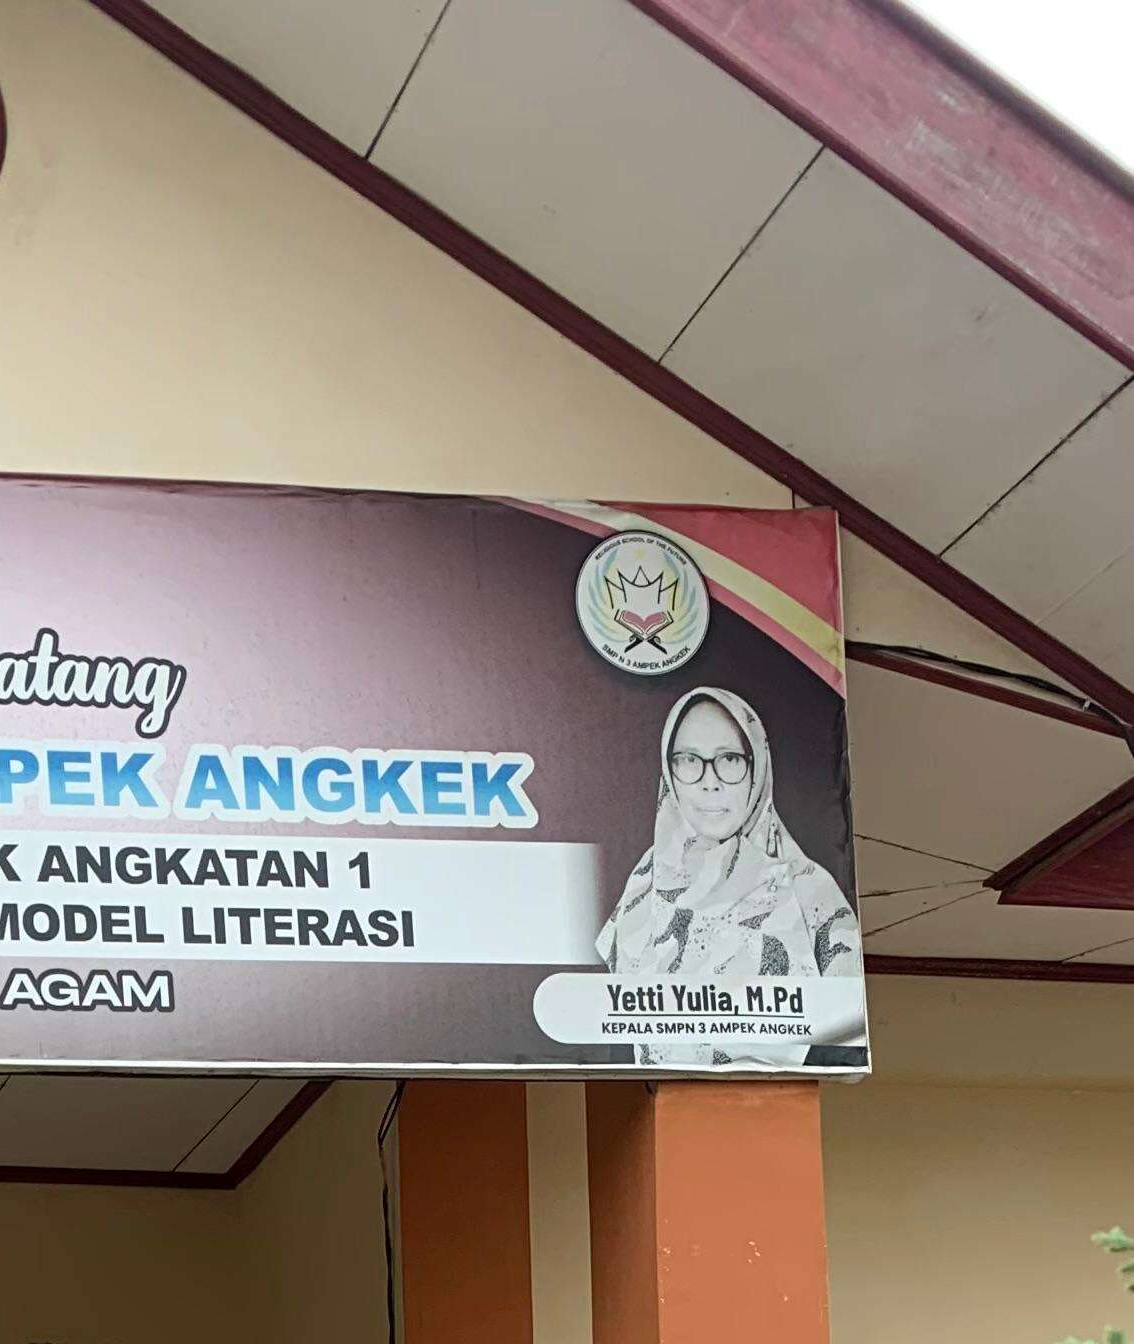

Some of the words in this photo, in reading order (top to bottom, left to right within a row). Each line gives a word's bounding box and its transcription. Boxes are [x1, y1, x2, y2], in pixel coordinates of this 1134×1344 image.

[632, 661, 661, 669] AMPEK
[662, 646, 691, 668] ANGKEK
[185, 753, 529, 818] ANGKEK
[37, 845, 330, 889] ANGKATAN
[348, 851, 372, 890] 1
[181, 907, 415, 947] LITERASI
[607, 983, 665, 1013] Yetti
[671, 984, 740, 1017] Yulia,
[747, 984, 805, 1014] M.Pd
[601, 1022, 652, 1035] KEPALA
[656, 1022, 695, 1035] SMPN
[698, 1022, 706, 1035] 3
[709, 1022, 756, 1036] AMPEK
[759, 1023, 812, 1037] ANGKEK
